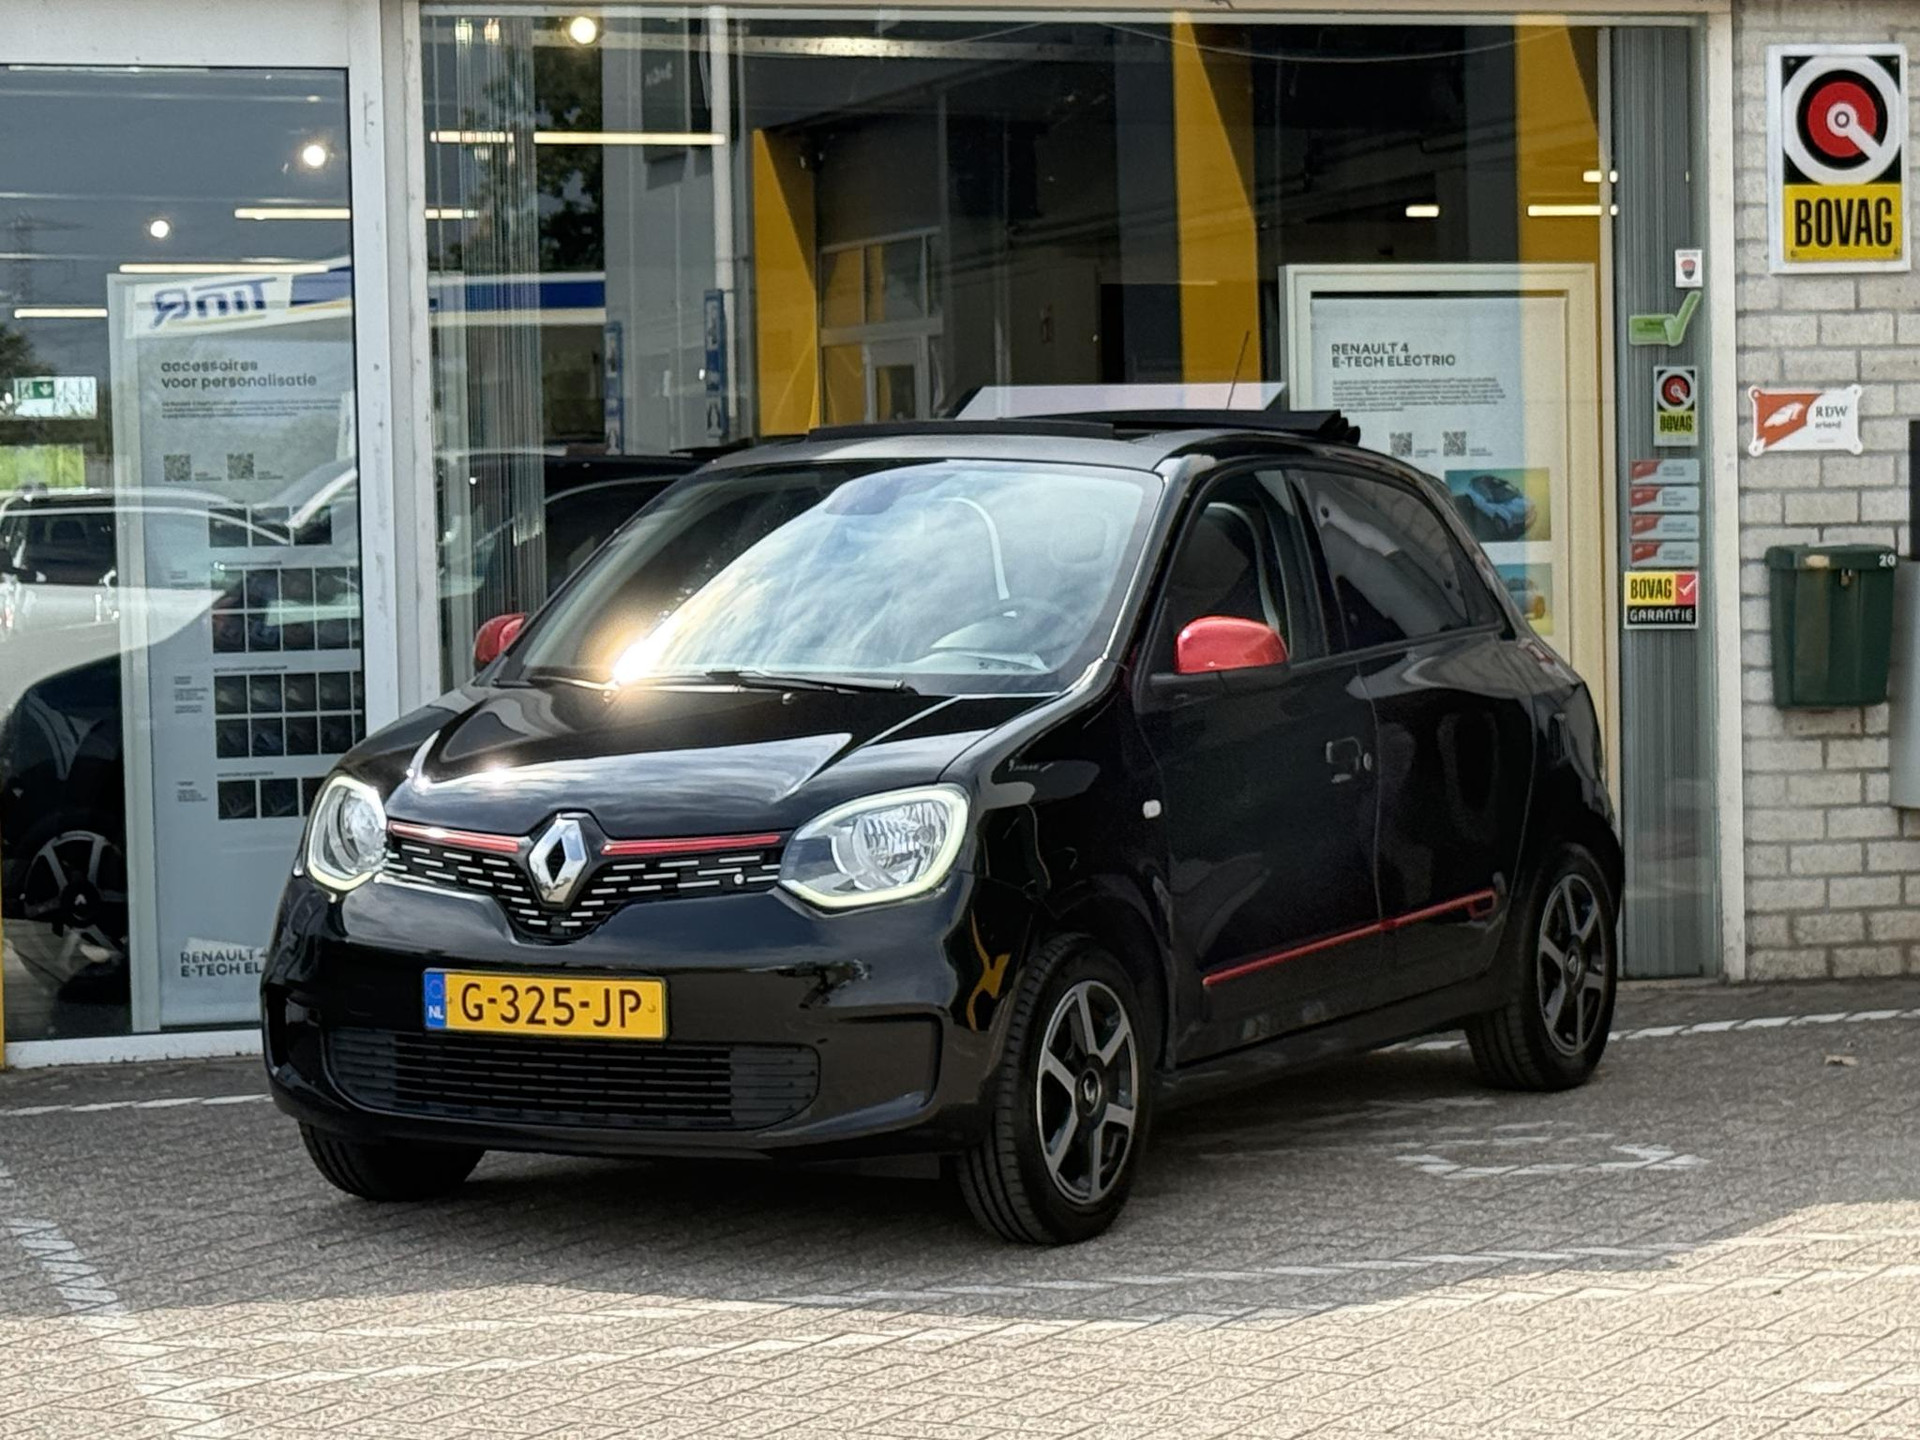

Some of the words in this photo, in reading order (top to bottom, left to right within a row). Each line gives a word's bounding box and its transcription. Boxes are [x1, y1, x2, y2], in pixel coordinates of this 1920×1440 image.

[1794, 197, 1893, 248] BOVAG
[1331, 342, 1398, 355] RENAULT
[1400, 342, 1409, 353] 4
[161, 360, 258, 373] accessoires
[1332, 356, 1384, 368] E-TECH
[161, 377, 198, 389] voor
[201, 373, 317, 391] personalisatie
[1815, 405, 1848, 418] RDW
[1660, 414, 1693, 433] BOVAG
[1879, 554, 1896, 567] 20
[1630, 578, 1672, 600] BOVAG
[1630, 608, 1694, 622] GARANTIE
[180, 949, 254, 963] RENAULT
[181, 963, 241, 977] E-TECH
[428, 1005, 444, 1019] NL
[461, 982, 642, 1028] G-325-JP
